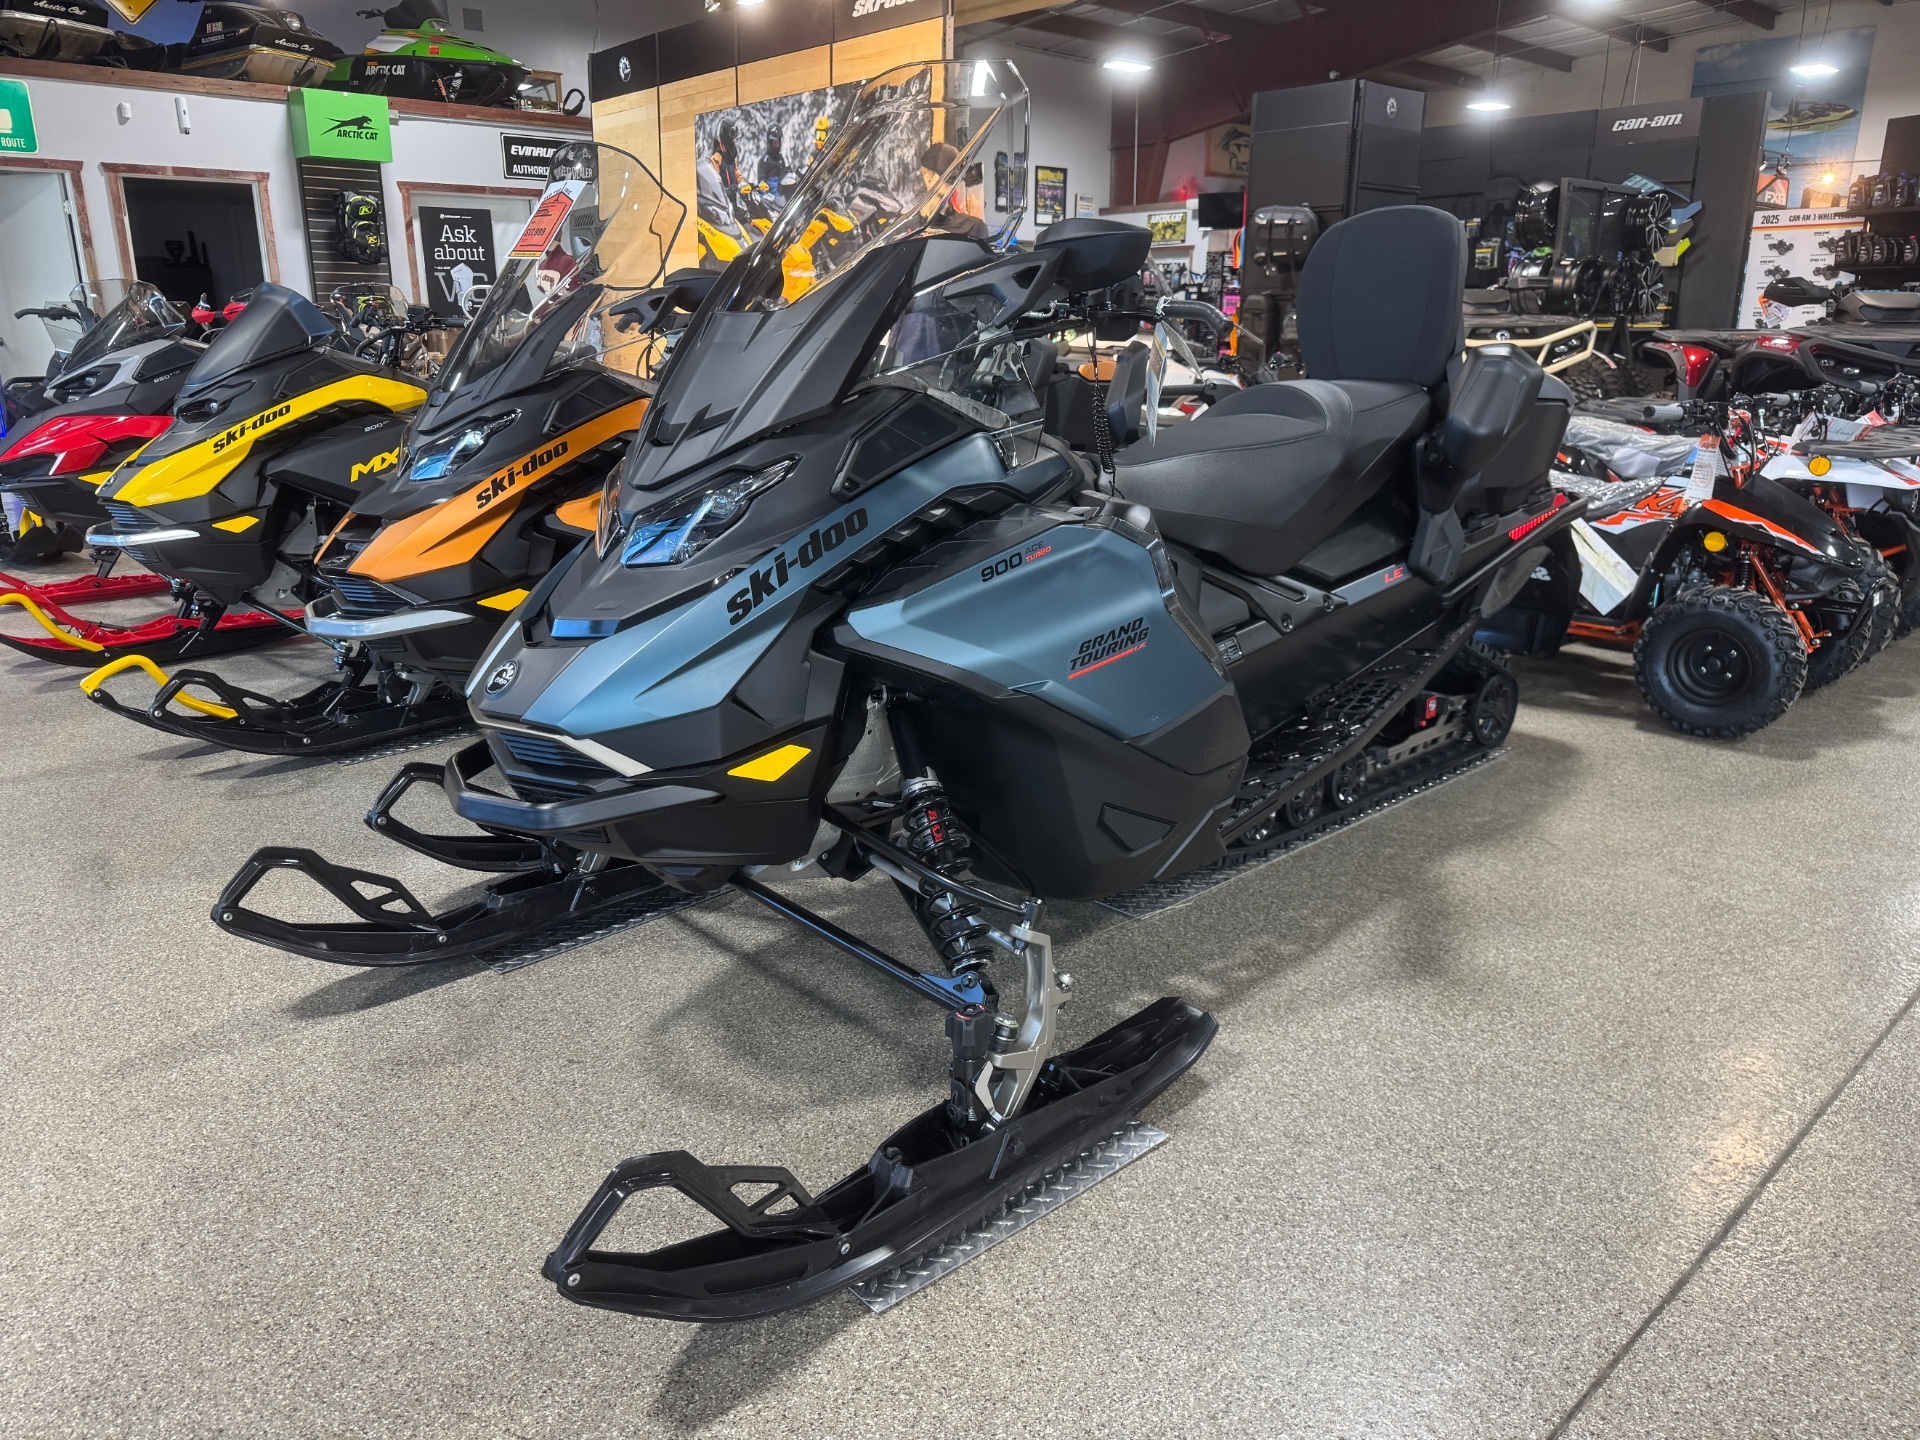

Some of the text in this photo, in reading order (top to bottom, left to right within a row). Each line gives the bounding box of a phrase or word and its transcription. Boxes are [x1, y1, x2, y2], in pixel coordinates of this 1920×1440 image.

[67, 6, 87, 16] Cat
[275, 38, 315, 52] Arctic Cat
[391, 64, 406, 76] CAT
[1612, 113, 1683, 132] can-am
[1, 136, 27, 148] ROUTE
[336, 128, 379, 141] ARCTIC CAT
[1760, 214, 1780, 225] 2025
[1788, 213, 1812, 223] CAN-AM
[440, 224, 478, 243] Ask
[434, 244, 486, 261] about
[213, 404, 291, 454] ski-doo
[476, 441, 569, 510] ski-doo
[981, 540, 1045, 583] 900 ACE
[1025, 546, 1053, 563] TURBO
[726, 507, 869, 626] ski-doo
[1384, 567, 1404, 584] LE
[1079, 617, 1144, 655] GRAND
[1070, 627, 1150, 671] TOURING
